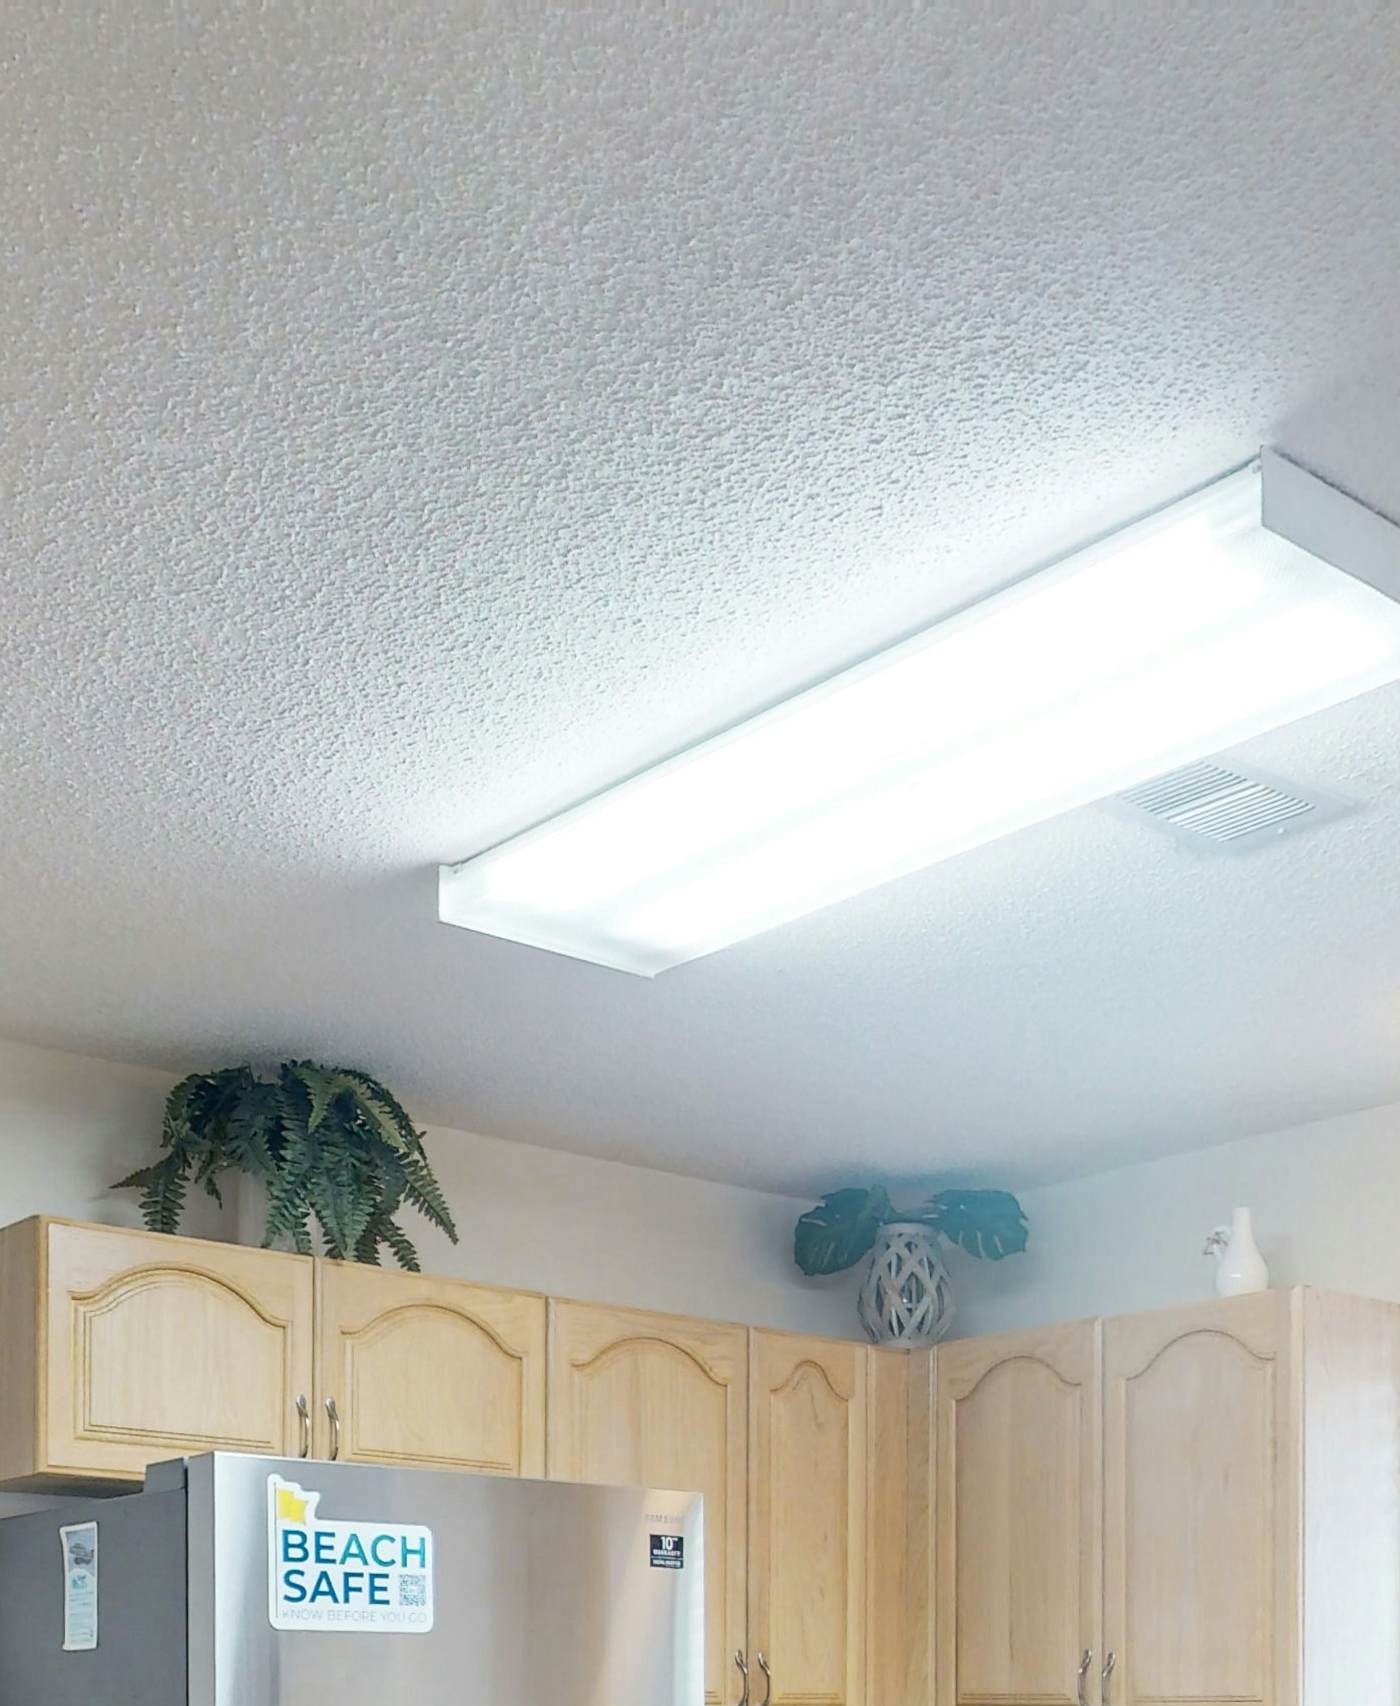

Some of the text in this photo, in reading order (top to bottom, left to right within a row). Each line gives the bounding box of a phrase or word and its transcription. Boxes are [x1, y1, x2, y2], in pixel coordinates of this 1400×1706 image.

[281, 1529, 426, 1569] BEACH
[660, 1536, 674, 1550] 10
[282, 1569, 391, 1606] SAFE
[281, 1609, 427, 1624] KNOW BEFORE YOU GO
